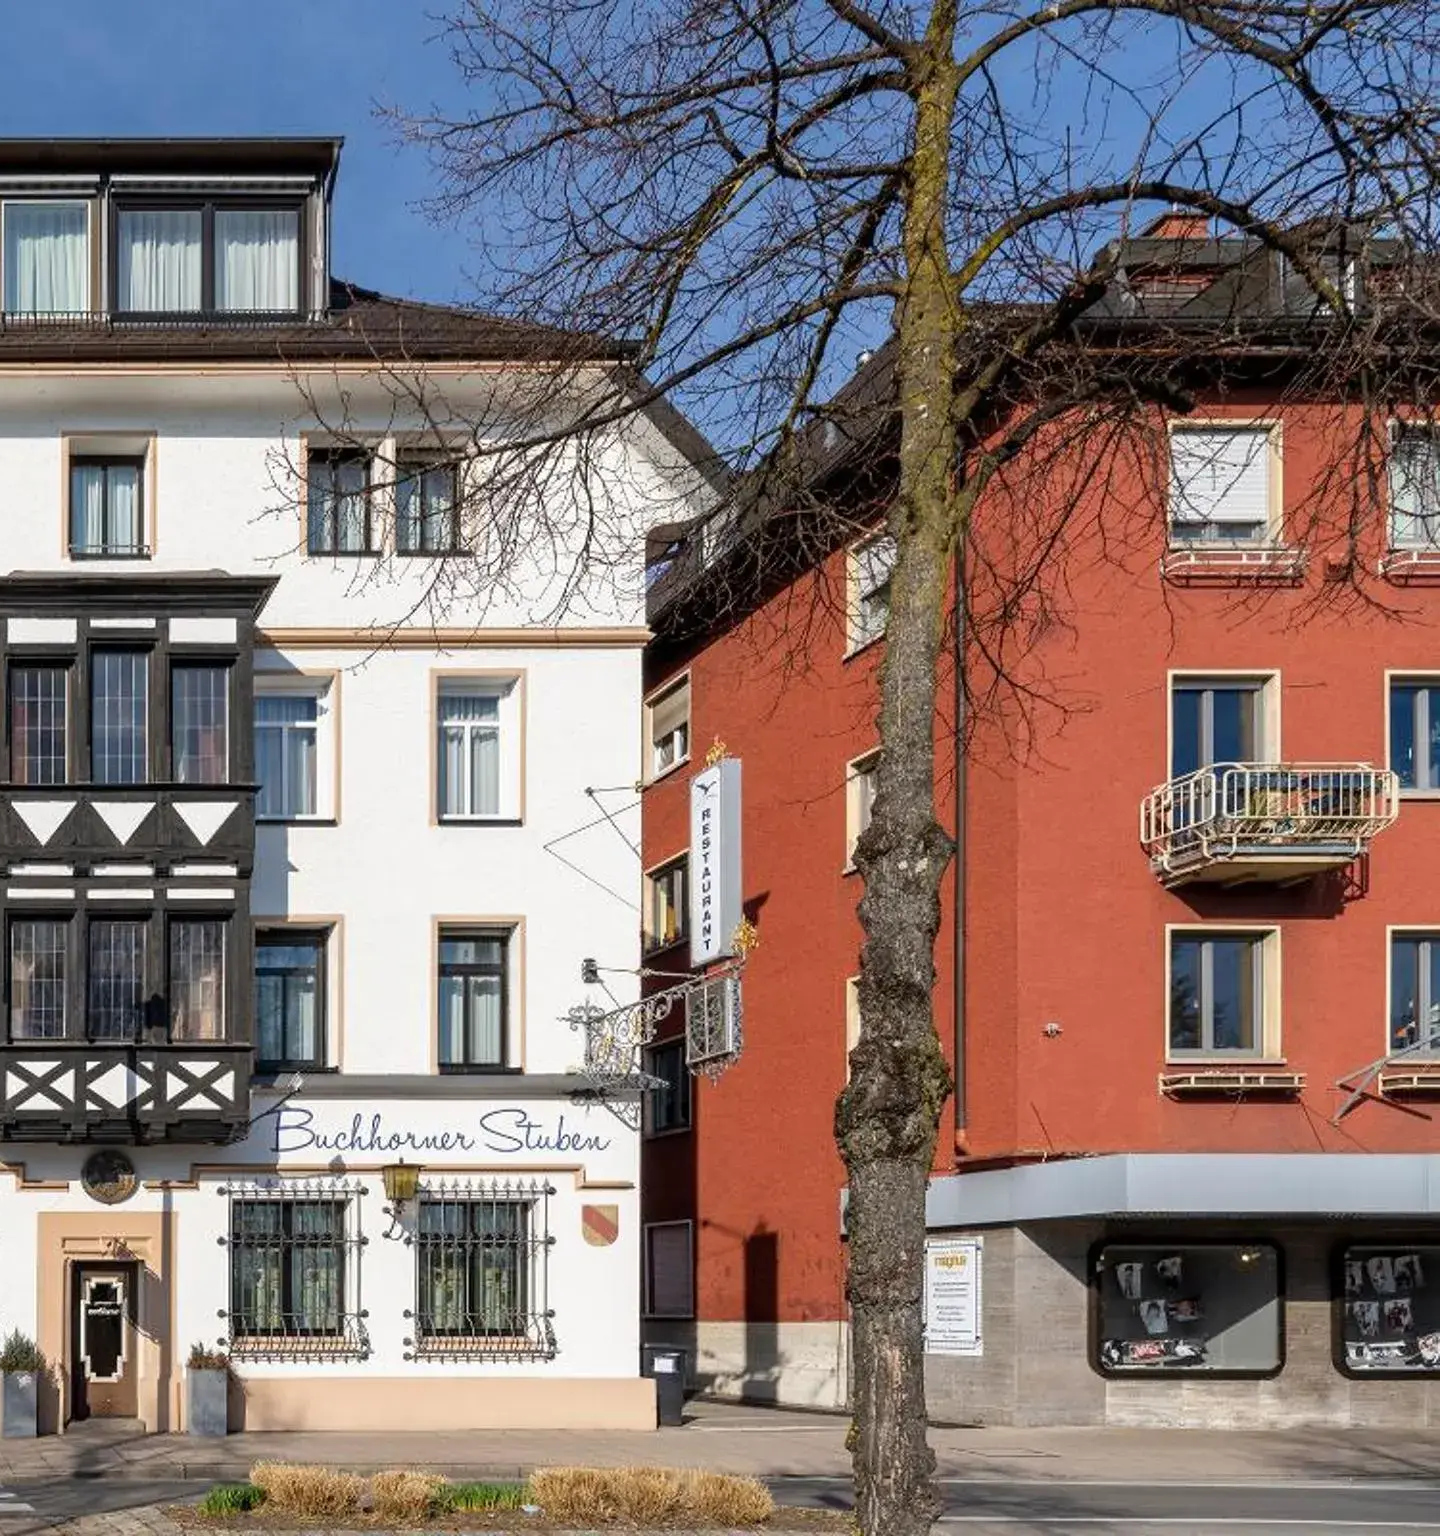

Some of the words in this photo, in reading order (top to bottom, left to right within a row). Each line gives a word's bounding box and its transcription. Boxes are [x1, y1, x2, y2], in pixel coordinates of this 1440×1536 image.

[701, 807, 712, 951] RESTAURANT
[269, 1106, 474, 1153] Buchhorner
[479, 1108, 611, 1153] Stuben
